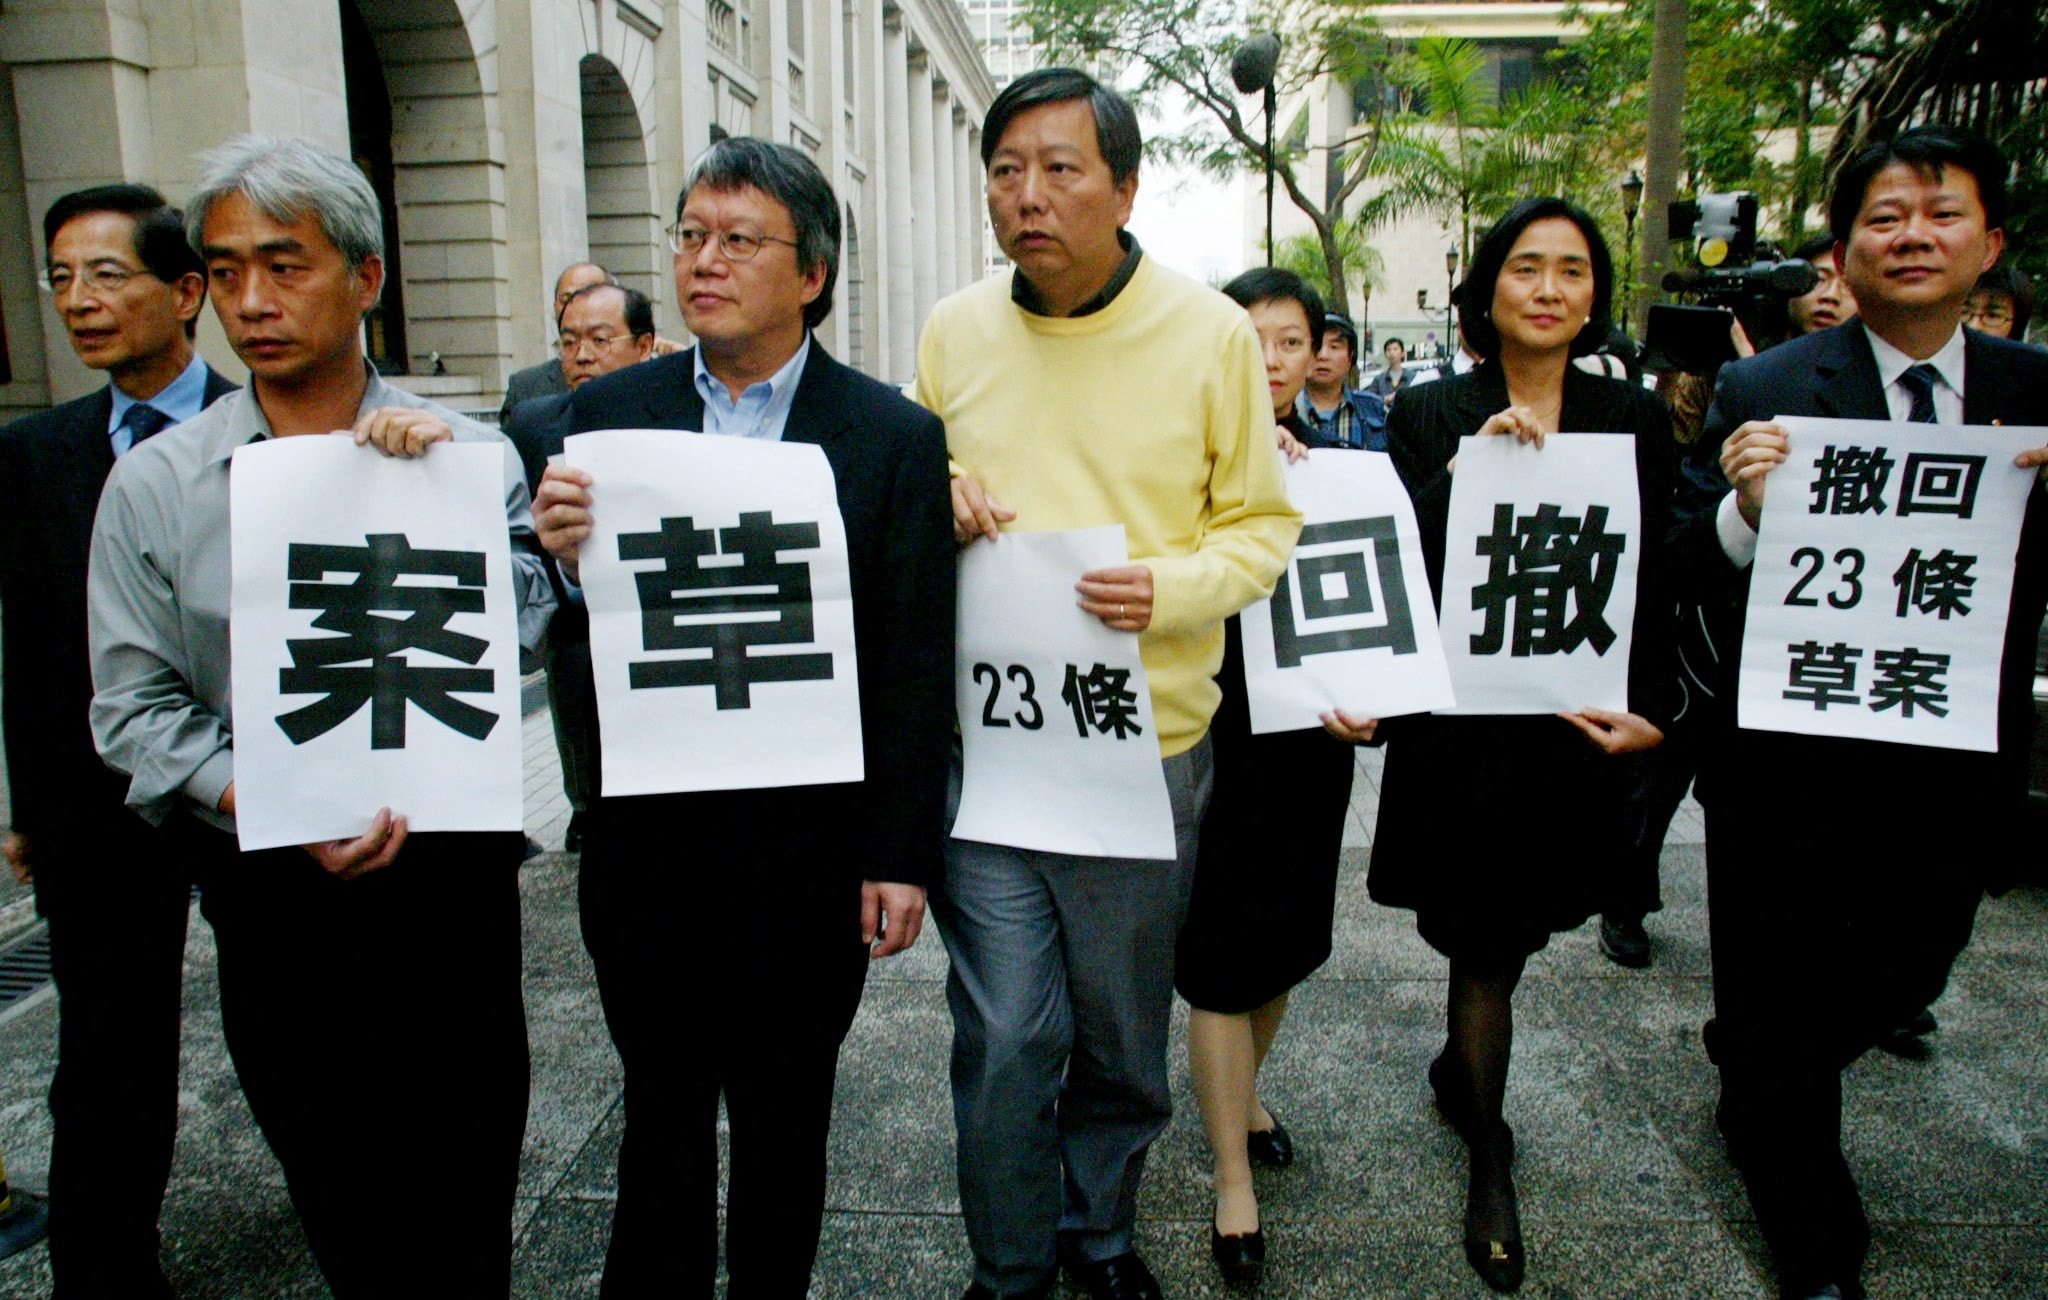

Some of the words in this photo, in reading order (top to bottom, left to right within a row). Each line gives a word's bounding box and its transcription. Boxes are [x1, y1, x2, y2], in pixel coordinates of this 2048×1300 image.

[1809, 445, 1987, 519] 撤回
[617, 511, 834, 710] 草
[1270, 515, 1417, 669] 回
[1470, 503, 1626, 658] 撤
[1784, 547, 1865, 609] 23
[1893, 548, 1977, 620] 條
[275, 534, 499, 750] 案
[1783, 641, 1950, 717] 草案
[973, 662, 1043, 730] 23
[1062, 663, 1142, 740] 條
